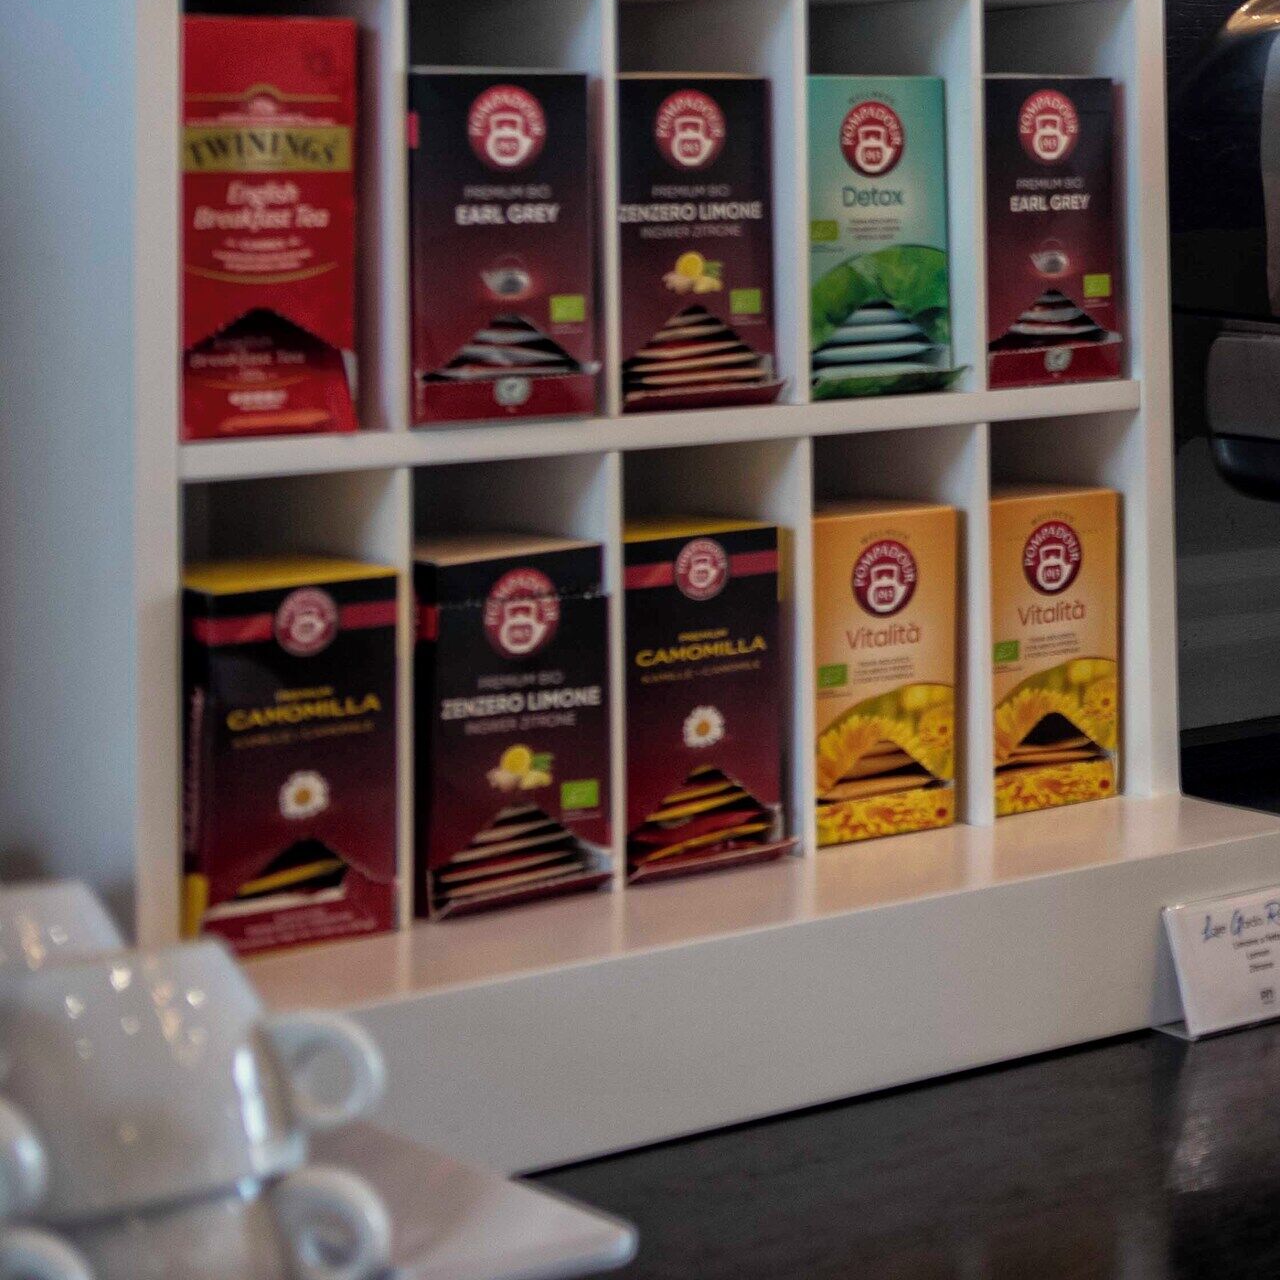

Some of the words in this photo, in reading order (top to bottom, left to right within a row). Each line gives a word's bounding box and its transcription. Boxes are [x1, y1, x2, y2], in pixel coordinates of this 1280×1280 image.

[841, 104, 903, 147] POMPADOUR
[1019, 95, 1079, 134] POMPADOUR
[187, 131, 338, 165] TWININGS
[617, 202, 697, 223] ZENZERO
[698, 201, 764, 220] LIMONE
[842, 185, 904, 208] Detox
[1009, 194, 1048, 213] EARL
[1049, 192, 1091, 211] GREY
[455, 204, 505, 226] EARL
[506, 203, 560, 224] GREY
[1023, 524, 1081, 568] POMPADOUR
[853, 542, 916, 588] POMPADOUR
[1017, 600, 1087, 626] Vitalità
[634, 635, 768, 668] CAMOMILLA
[845, 622, 922, 650] Vitalità
[226, 693, 382, 731] CAMOMILLA
[440, 692, 525, 721] ZENZERO
[526, 685, 602, 711] LIMONE
